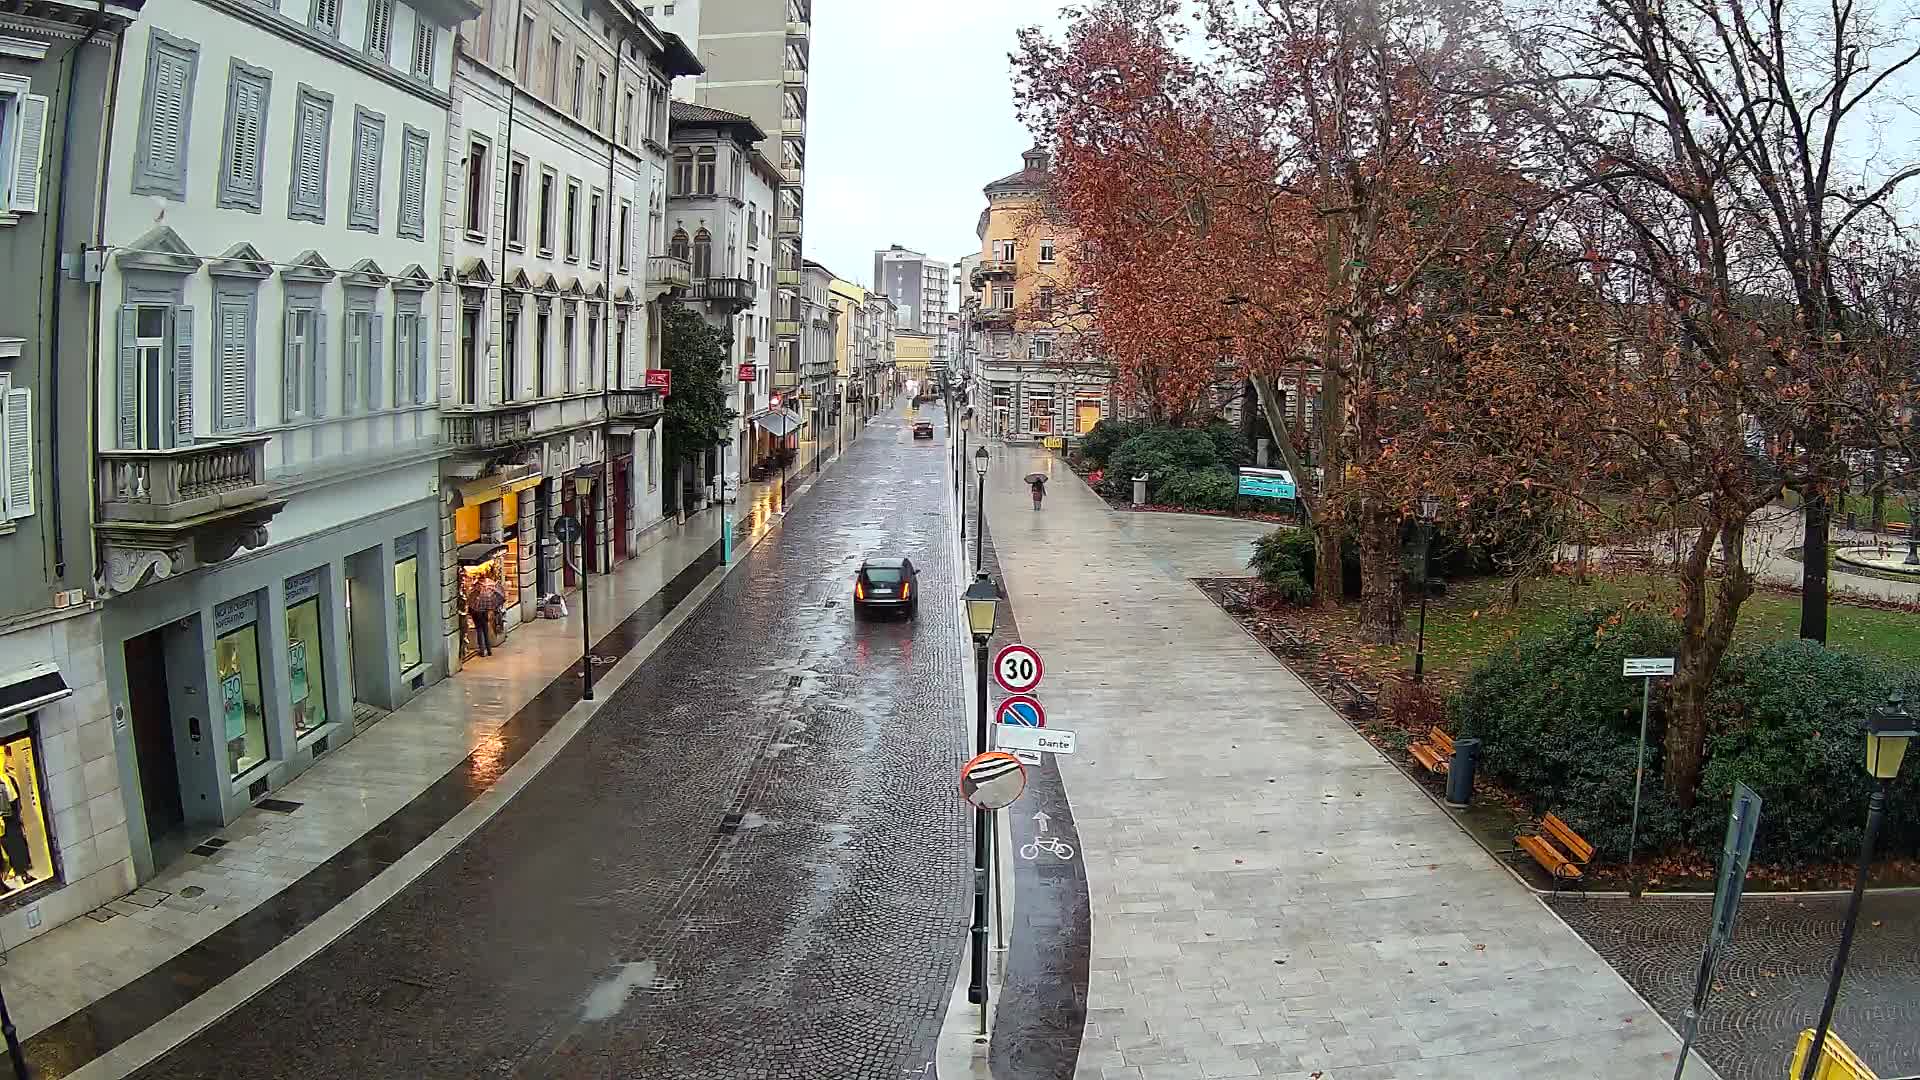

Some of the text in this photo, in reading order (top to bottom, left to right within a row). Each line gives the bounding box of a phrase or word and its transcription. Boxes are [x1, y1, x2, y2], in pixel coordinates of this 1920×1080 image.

[1005, 659, 1033, 680] 30
[222, 677, 241, 701] 130
[1038, 738, 1070, 749] Dante
